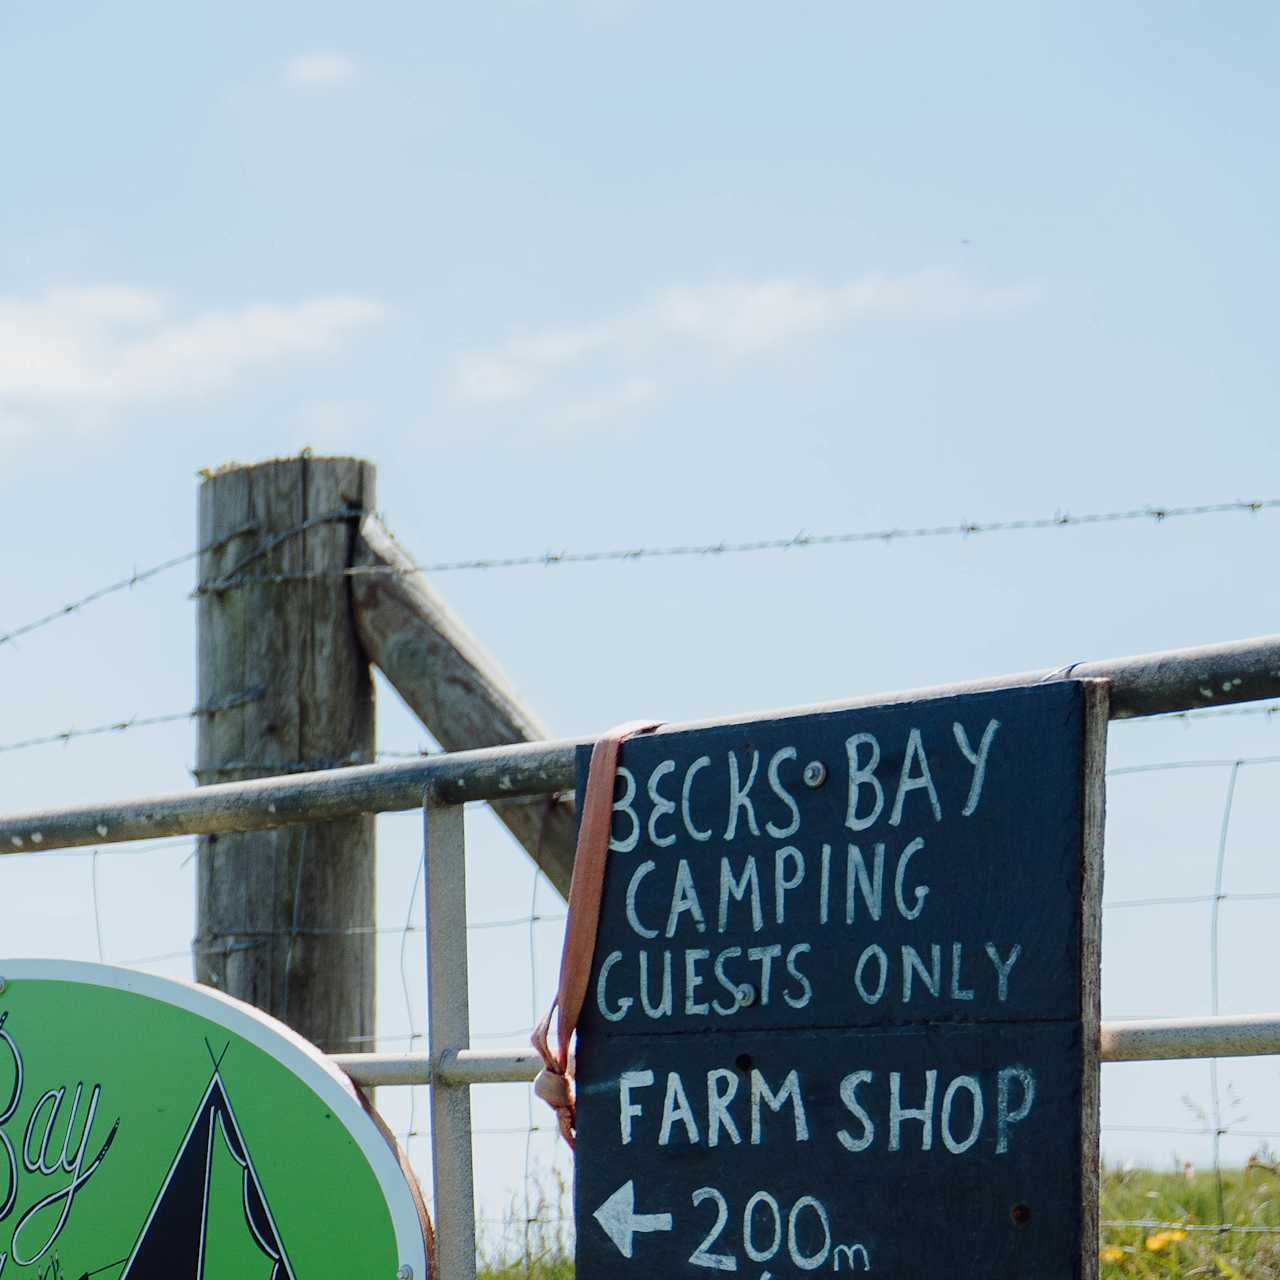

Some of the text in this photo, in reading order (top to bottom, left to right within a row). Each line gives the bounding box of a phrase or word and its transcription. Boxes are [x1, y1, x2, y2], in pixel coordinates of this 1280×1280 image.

[609, 718, 1002, 853] BECKS BAY
[625, 836, 930, 939] CAMPING
[596, 942, 1022, 1023] GUESTS ONLY
[619, 1068, 1036, 1155] FARM SHOP
[688, 1186, 872, 1272] 200m
